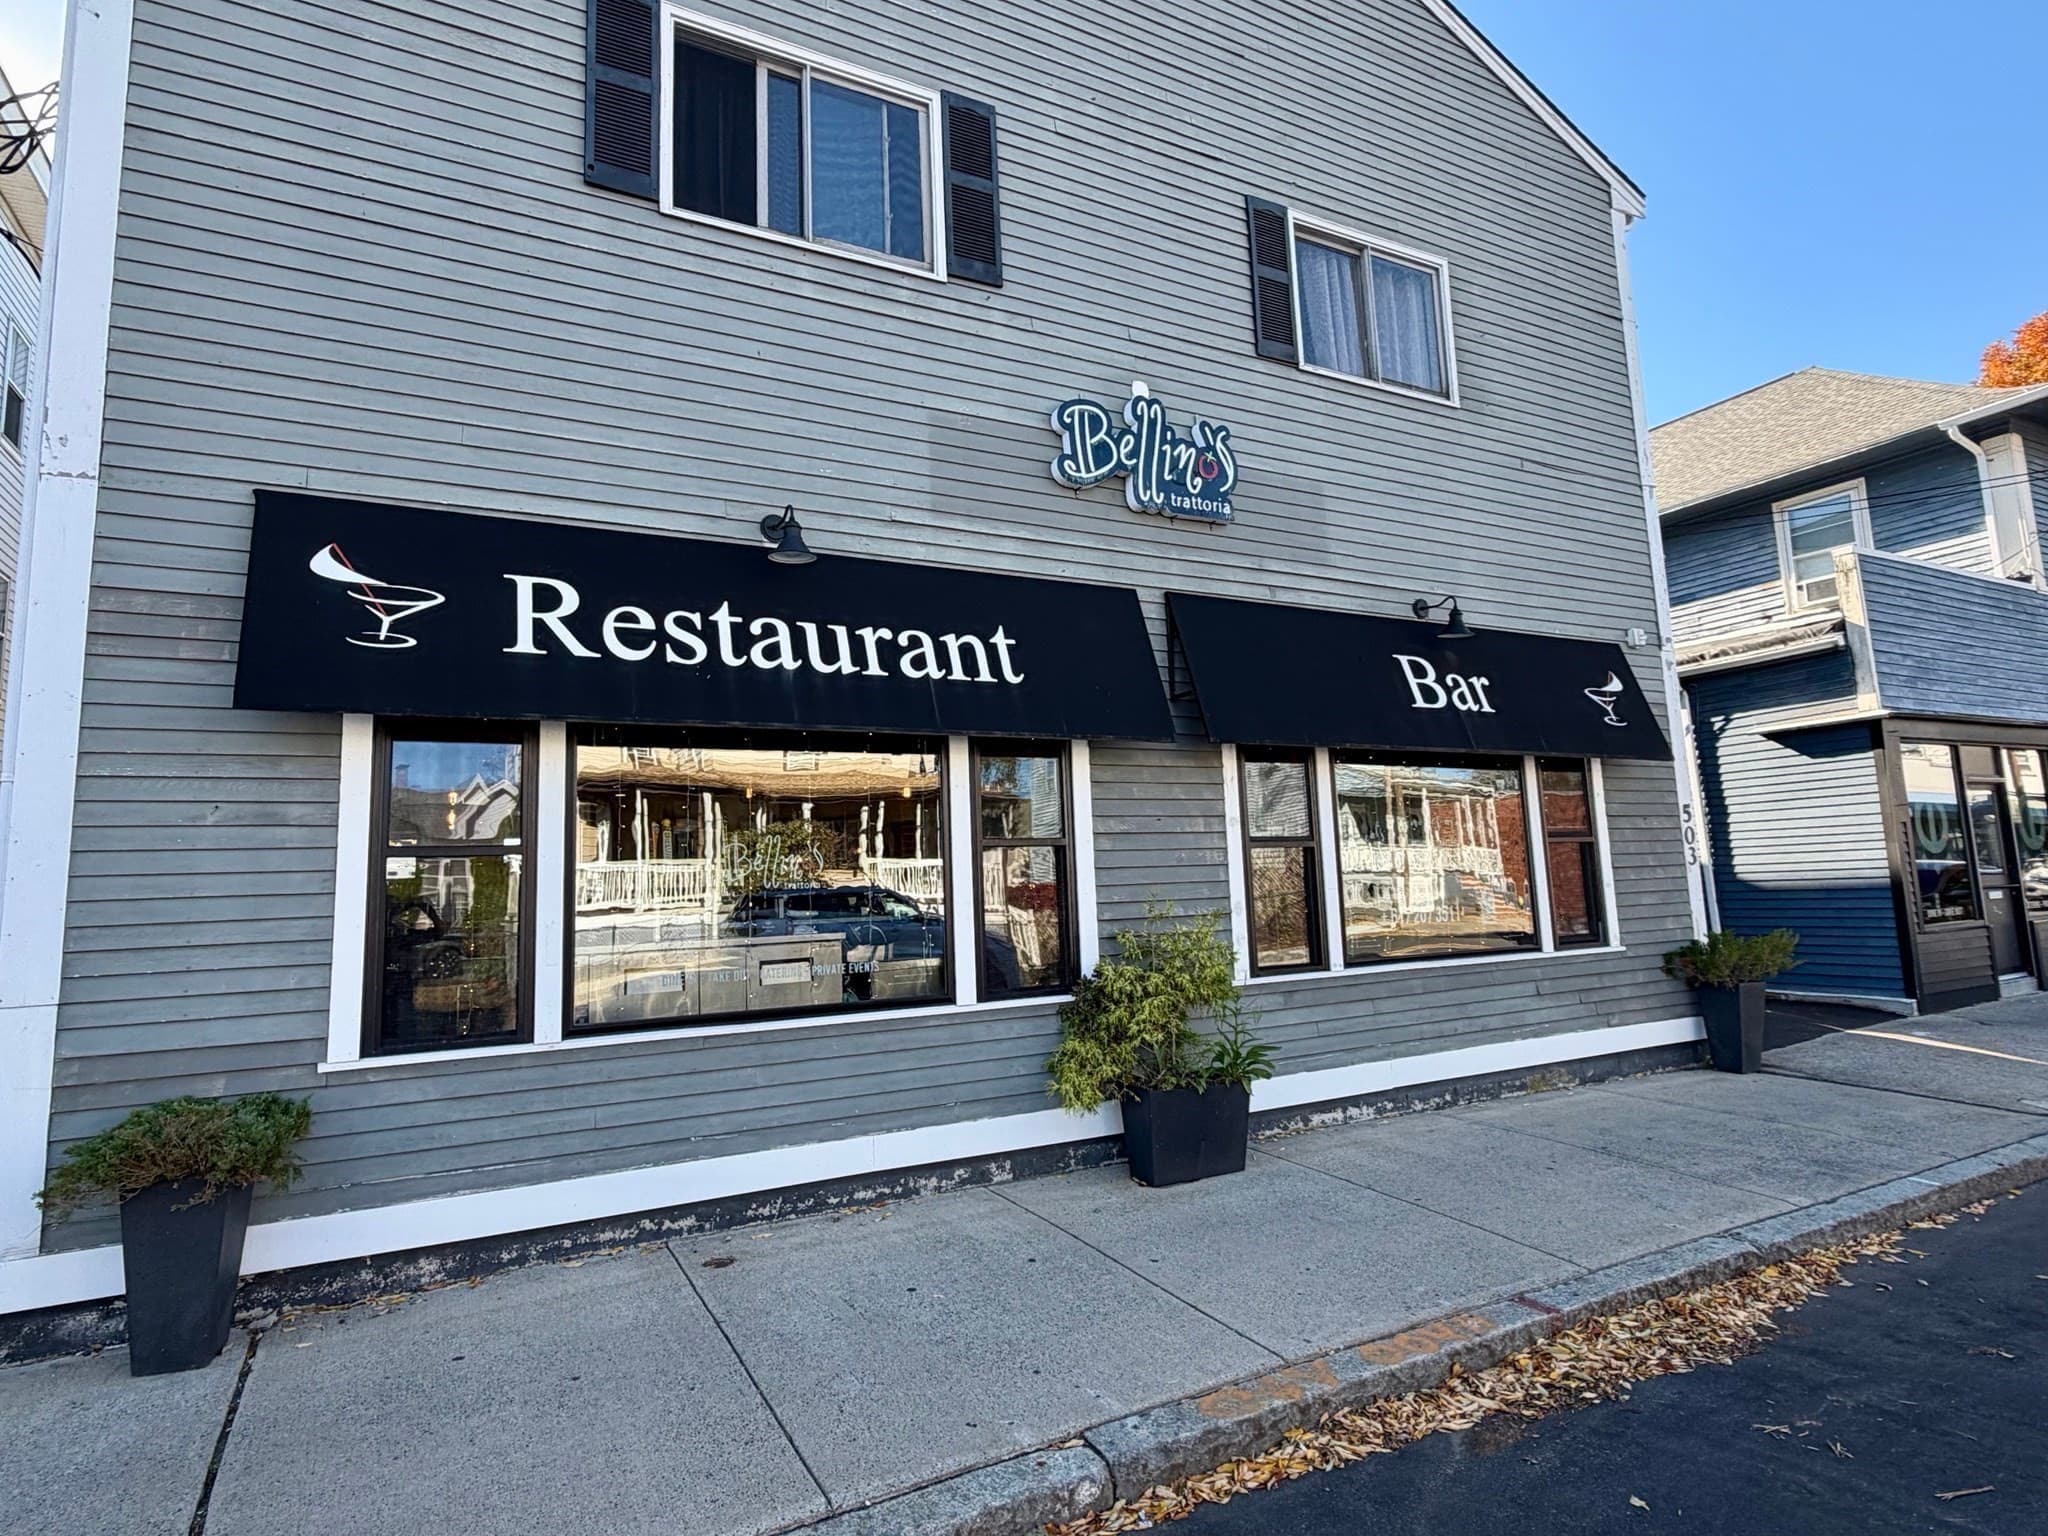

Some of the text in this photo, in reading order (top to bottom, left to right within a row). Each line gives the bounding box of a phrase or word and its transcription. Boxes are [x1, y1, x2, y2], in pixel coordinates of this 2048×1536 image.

[1063, 400, 1235, 504] Bellino's
[1170, 492, 1231, 515] trattoria
[502, 573, 1024, 685] Restaurant
[1391, 653, 1496, 713] Bar
[1682, 803, 1697, 866] 503
[812, 962, 847, 976] PRIVATE
[848, 960, 880, 974] EVENTS
